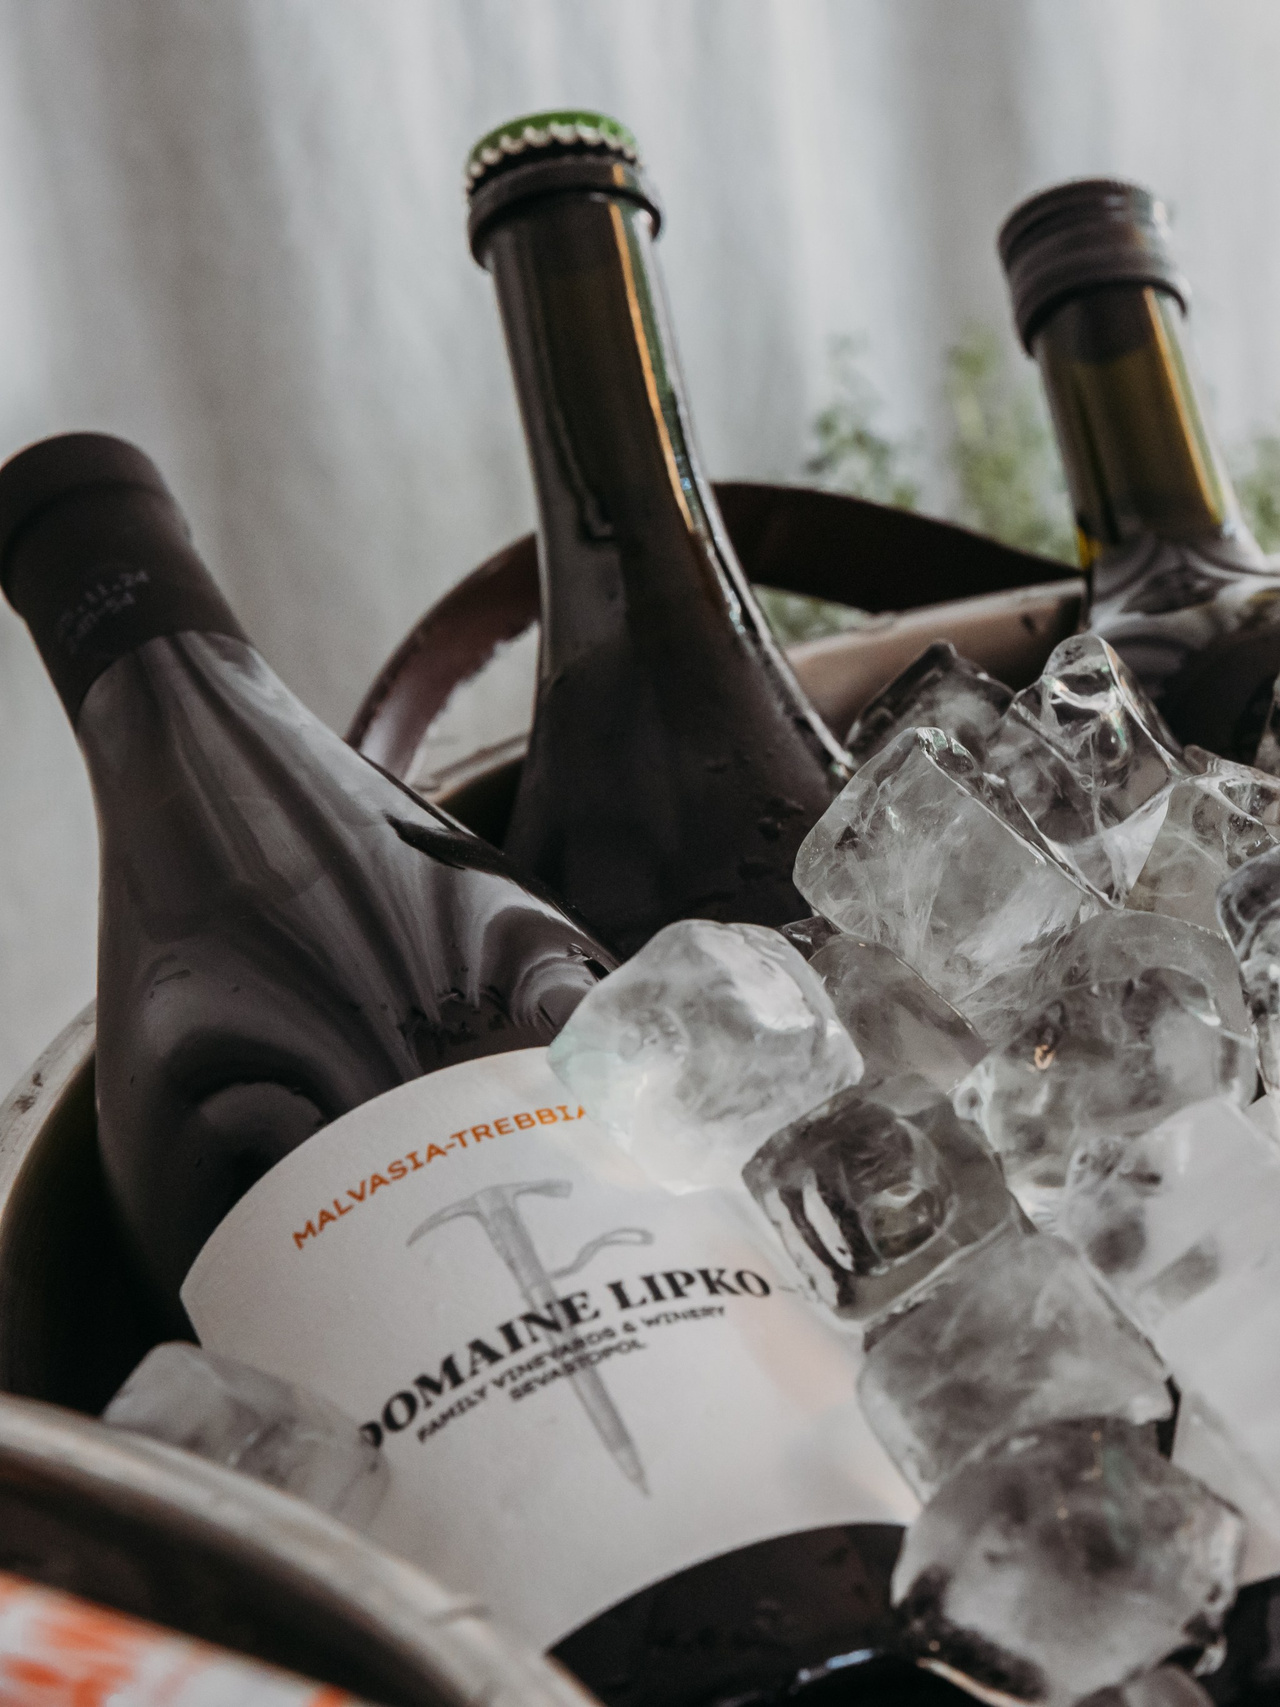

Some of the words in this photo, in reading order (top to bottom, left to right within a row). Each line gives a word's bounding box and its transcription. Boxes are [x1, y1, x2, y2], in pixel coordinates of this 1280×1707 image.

[606, 1268, 771, 1310] LIPKO
[416, 1386, 488, 1444] FAMILY
[491, 1326, 617, 1389] VINEYARDS
[622, 1320, 638, 1334] &
[641, 1305, 725, 1328] WINERY
[508, 1339, 647, 1401] SEVASTOPOL
